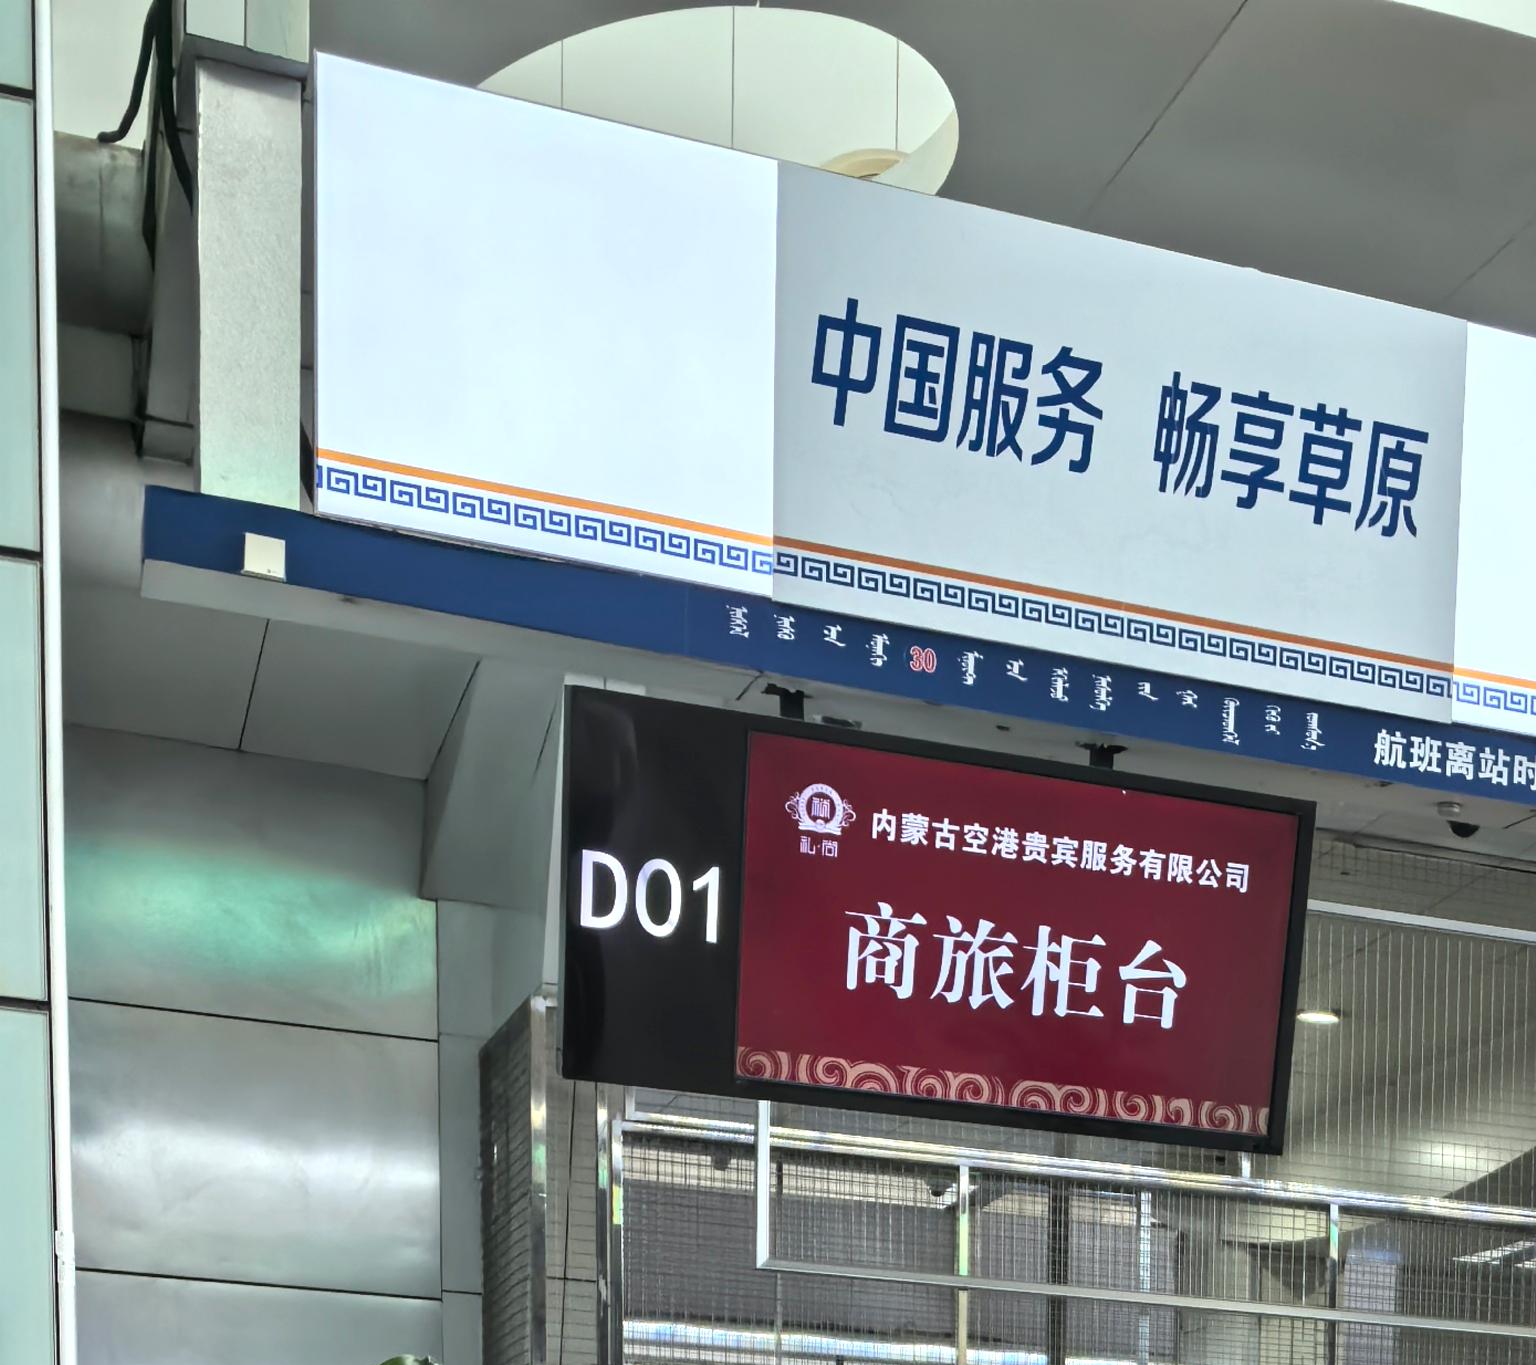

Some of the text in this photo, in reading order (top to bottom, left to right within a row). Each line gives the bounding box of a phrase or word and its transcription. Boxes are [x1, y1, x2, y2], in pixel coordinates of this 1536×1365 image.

[810, 296, 1430, 538] 中国服务 畅享草原
[909, 645, 938, 674] 30
[579, 849, 722, 944] D01
[871, 808, 1251, 893] 内蒙古空港贵宾服务有限公司
[844, 900, 1188, 1031] 商旅柜台
